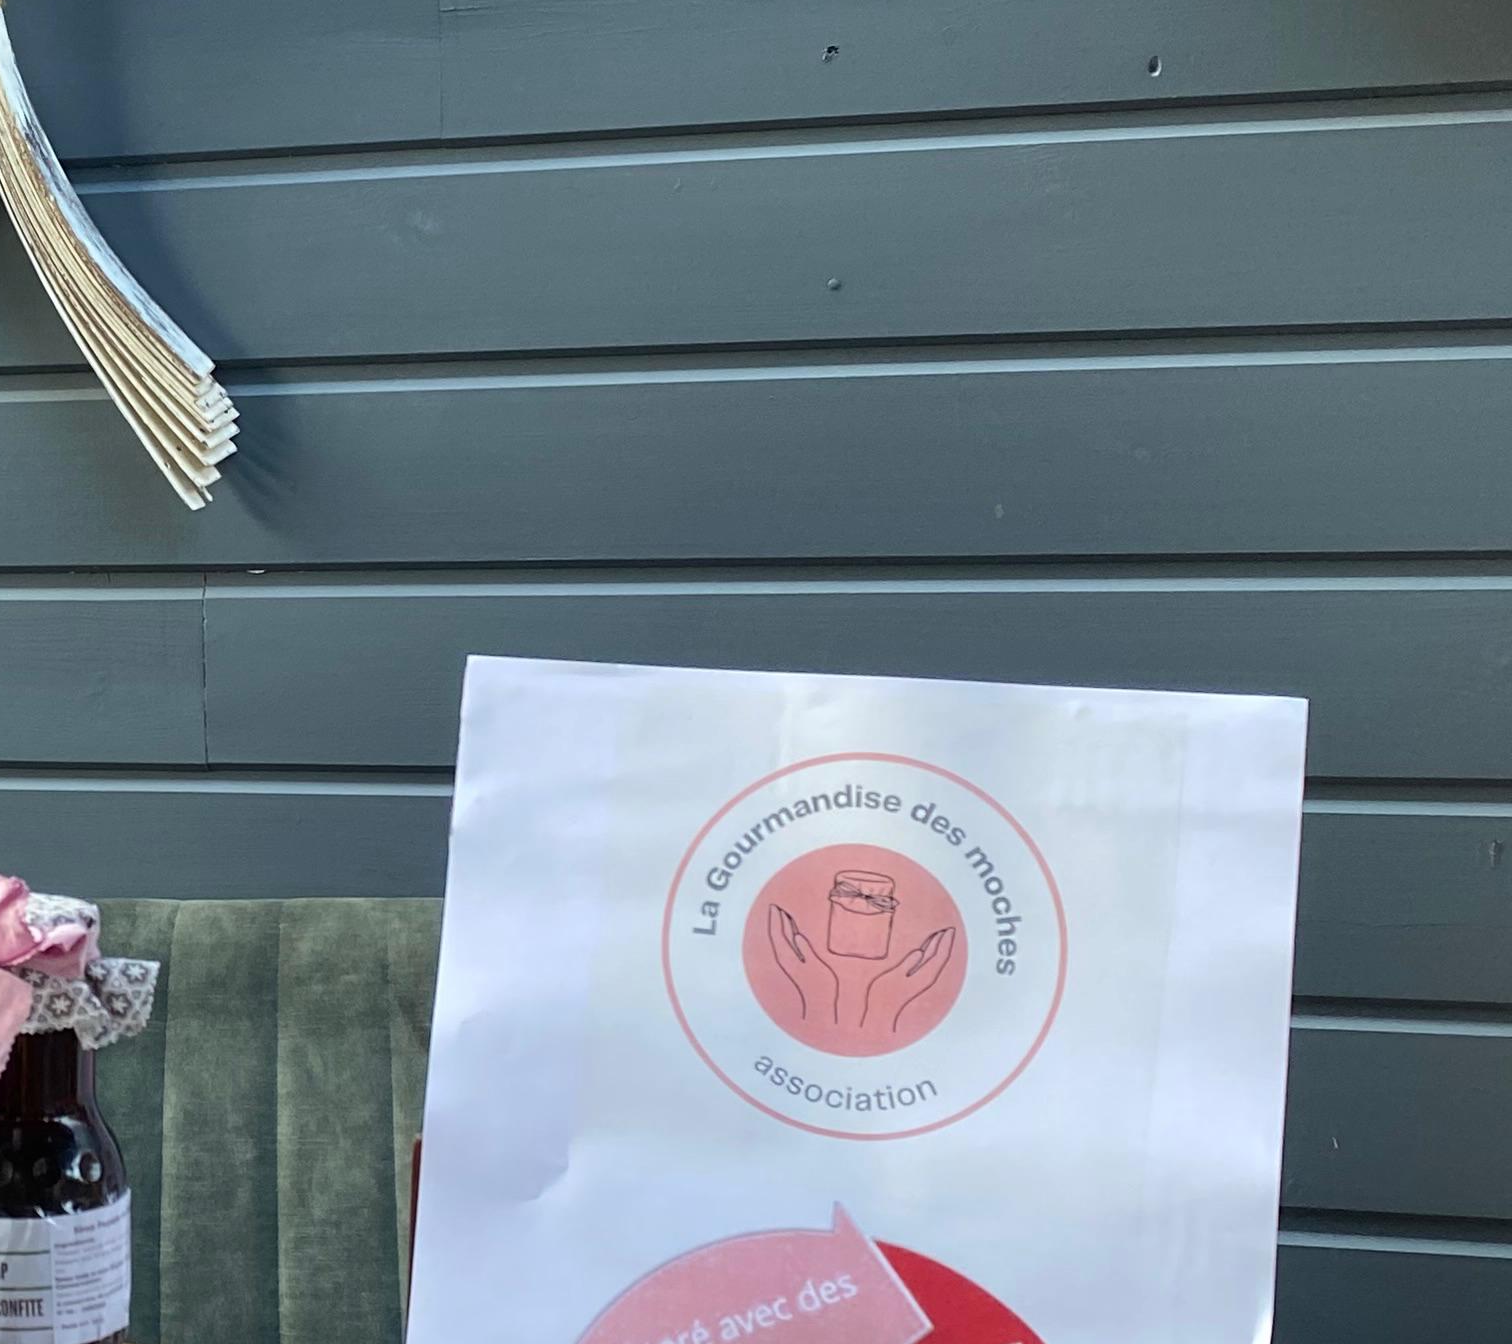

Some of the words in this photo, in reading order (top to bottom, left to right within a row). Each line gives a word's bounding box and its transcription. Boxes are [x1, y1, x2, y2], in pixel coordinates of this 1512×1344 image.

[705, 784, 902, 893] Gourmandise
[909, 802, 967, 848] des
[692, 899, 720, 936] La
[963, 844, 1023, 978] moches
[753, 1054, 938, 1112] association
[718, 1295, 793, 1342] avec
[796, 1273, 859, 1313] des
